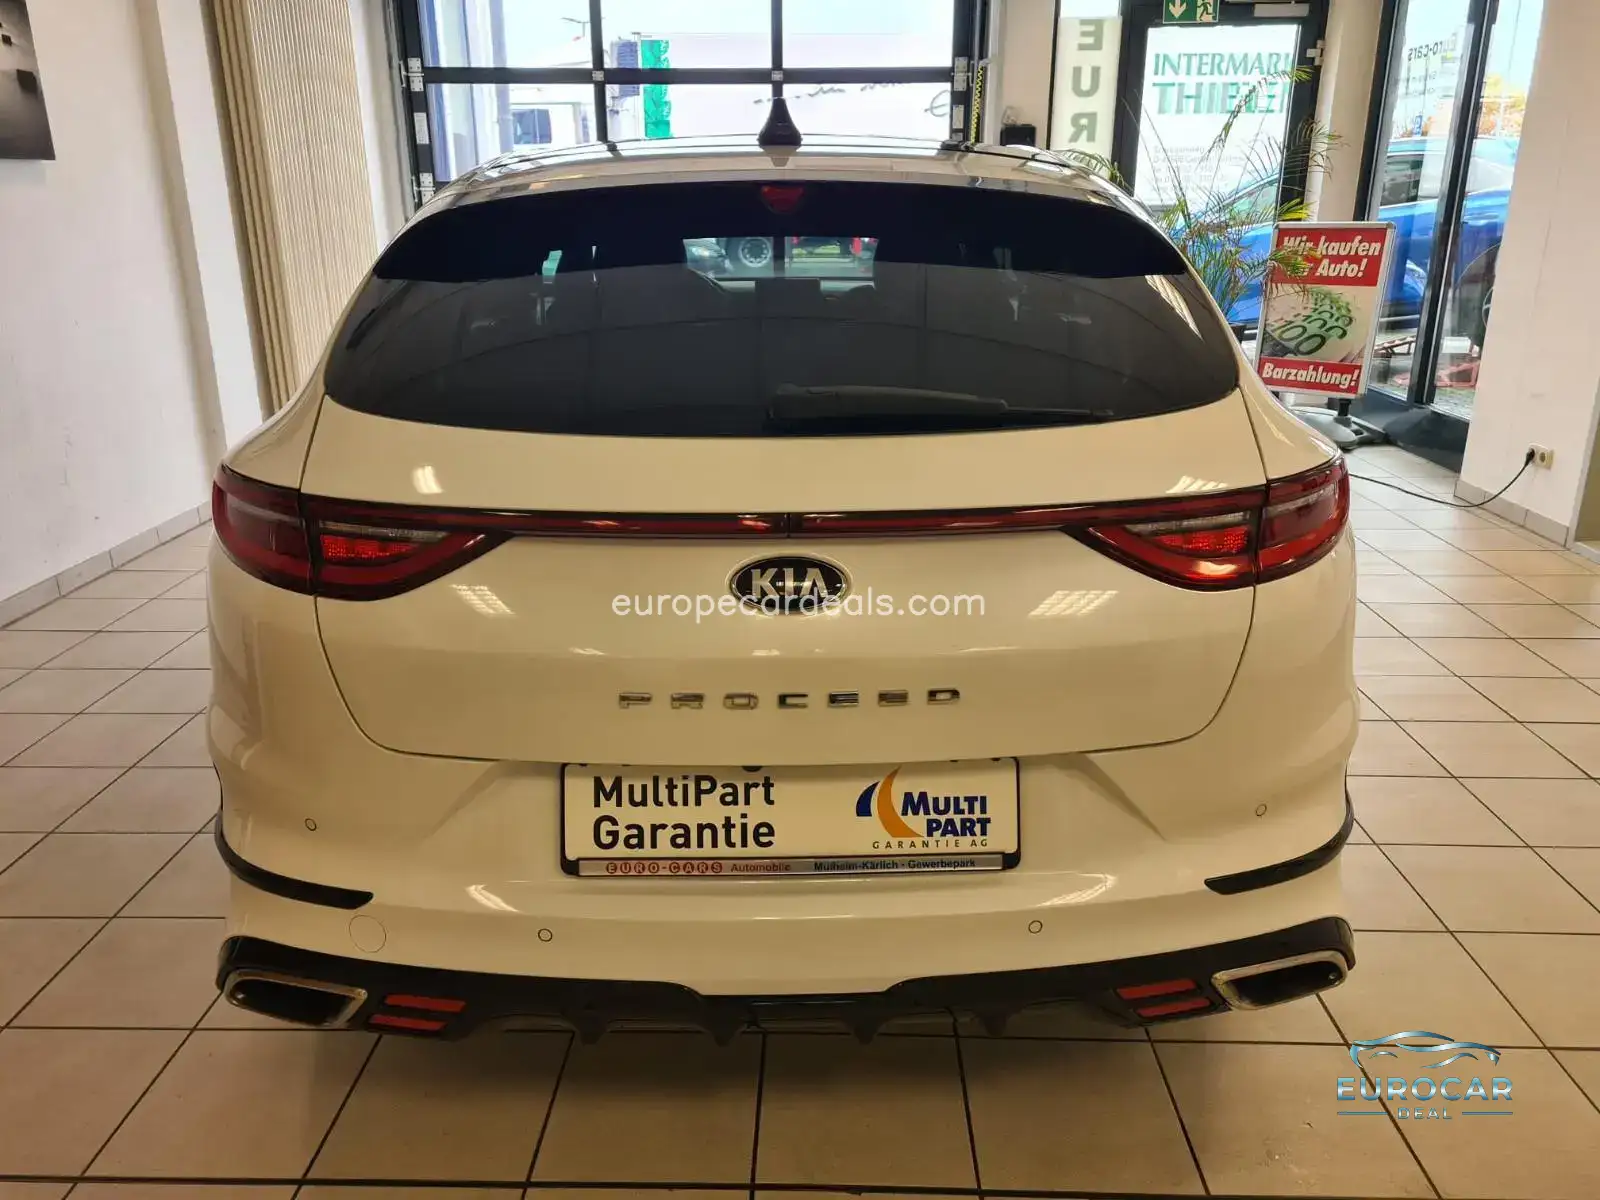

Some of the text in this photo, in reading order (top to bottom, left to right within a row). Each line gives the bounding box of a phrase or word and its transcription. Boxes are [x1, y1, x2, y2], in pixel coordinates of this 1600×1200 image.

[1317, 235, 1382, 256] kaufen
[1315, 258, 1367, 278] Auto!
[1262, 362, 1358, 389] Barzahlung!
[750, 567, 828, 598] KIA
[618, 687, 961, 709] PROCEED
[593, 775, 775, 808] MultiPart
[901, 791, 987, 816] MULTI
[593, 813, 775, 850] Garantie
[926, 818, 991, 838] PART
[872, 838, 988, 849] GARANTIE AG
[605, 861, 723, 874] EURO-CARS
[908, 859, 976, 870] Gewerbepark
